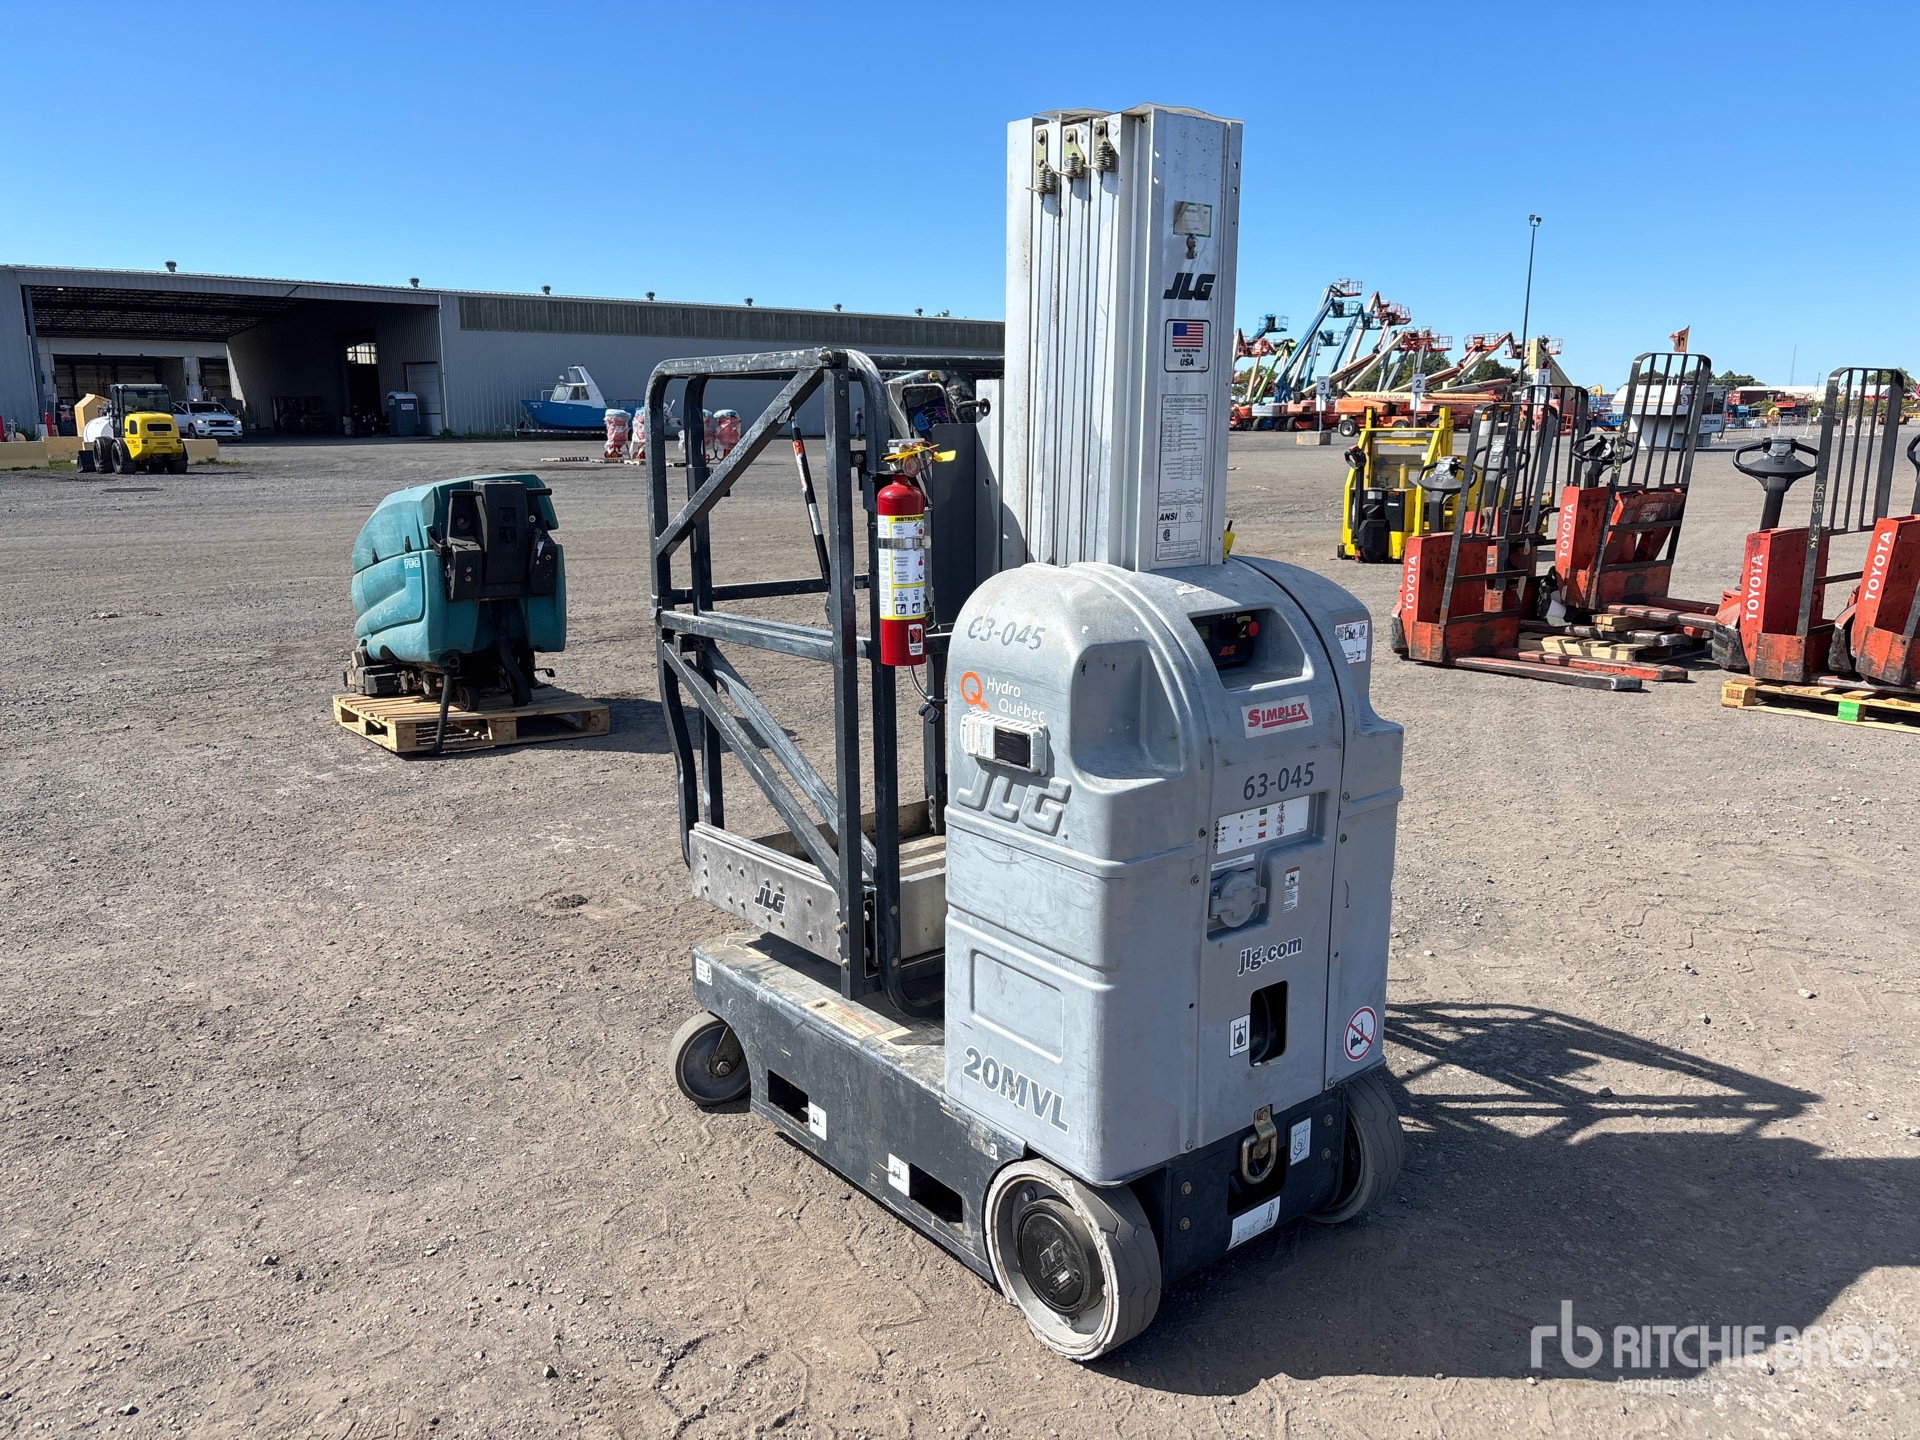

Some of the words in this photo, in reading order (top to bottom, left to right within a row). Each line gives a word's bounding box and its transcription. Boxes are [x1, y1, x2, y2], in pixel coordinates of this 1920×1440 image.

[1163, 272, 1216, 301] JLG
[1180, 358, 1195, 367] USA
[1320, 381, 1326, 391] 3
[1415, 379, 1422, 389] 2
[1159, 512, 1178, 522] ANSI
[1558, 503, 1574, 559] TOYOTA
[1864, 531, 1892, 601] TOYOTA
[1404, 555, 1418, 611] TOYOTA
[1745, 554, 1764, 621] TOYOTA
[967, 614, 1047, 650] 63-045
[986, 676, 1021, 698] Hydro
[998, 697, 1046, 723] Québec
[1247, 702, 1308, 728] SIMPLEX
[1243, 761, 1316, 801] 63-045
[956, 768, 1072, 837] JLG
[753, 885, 787, 916] JLG
[1237, 936, 1303, 977] jlg.com
[962, 1044, 1071, 1136] 20MVL
